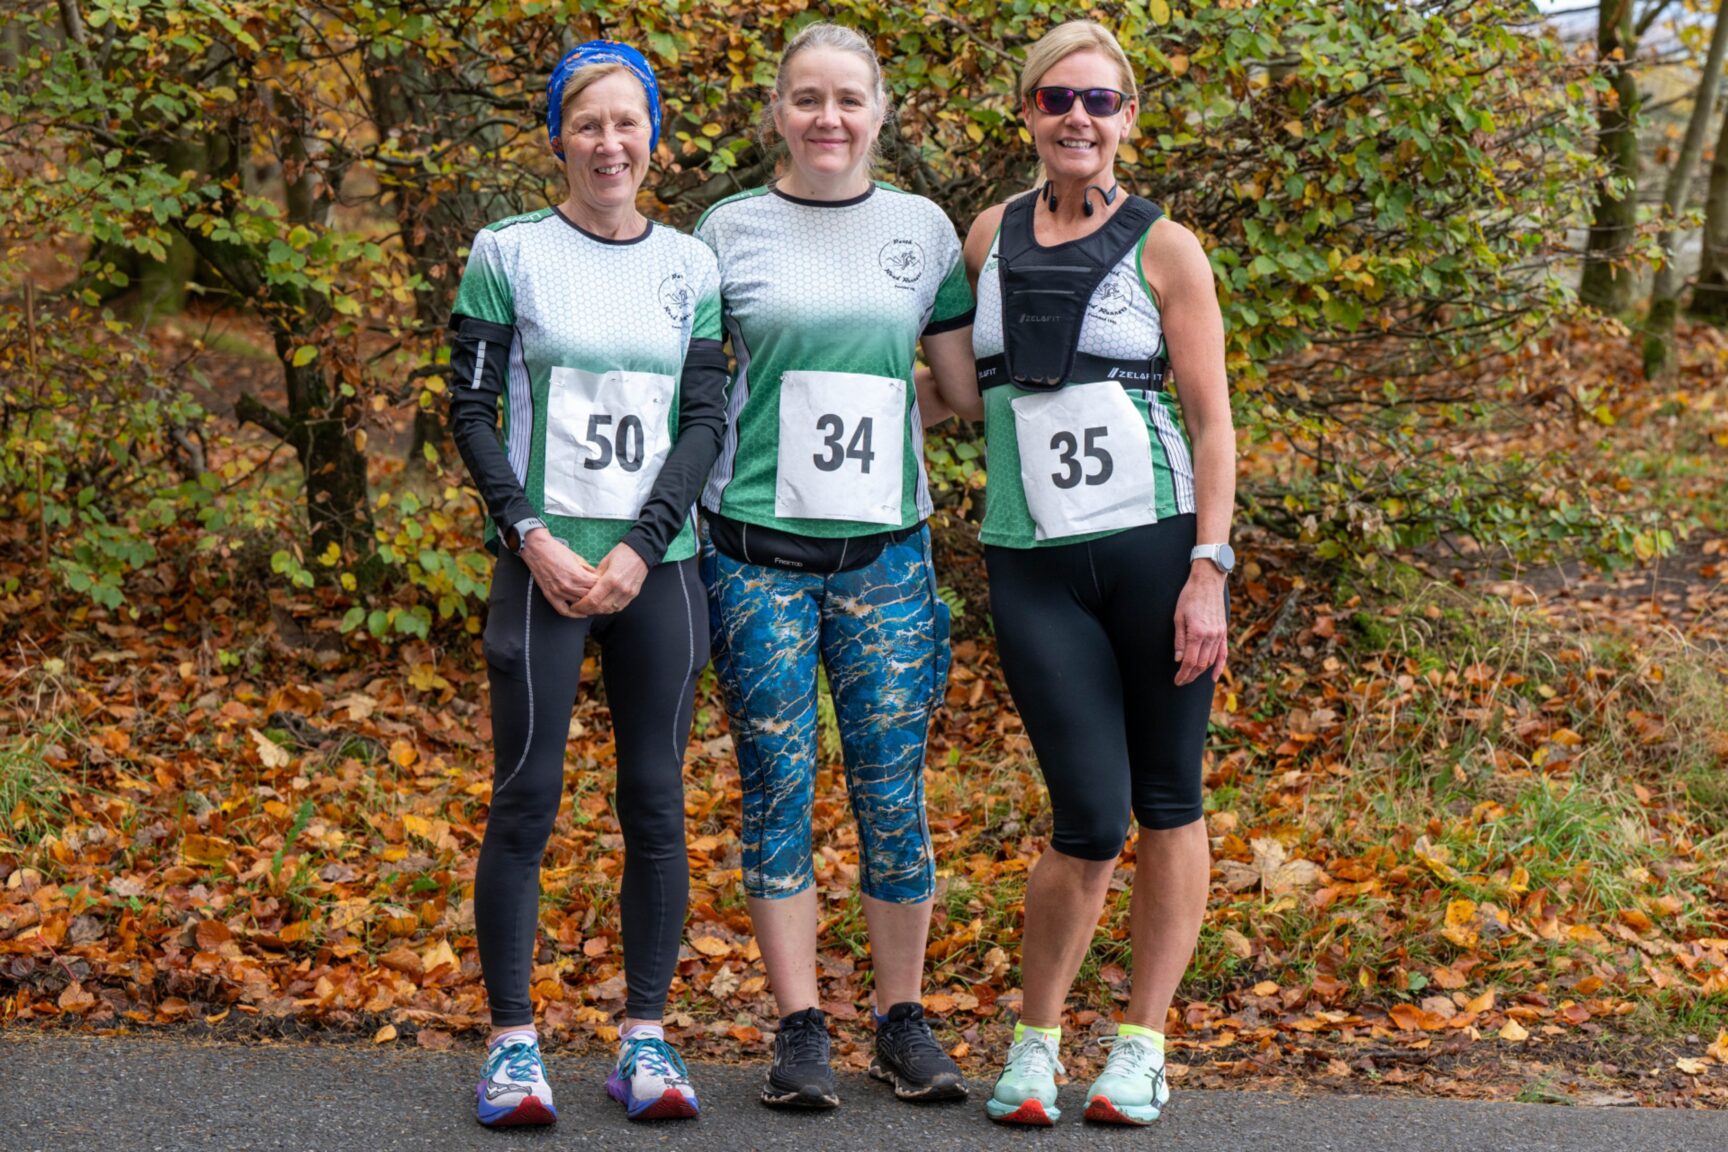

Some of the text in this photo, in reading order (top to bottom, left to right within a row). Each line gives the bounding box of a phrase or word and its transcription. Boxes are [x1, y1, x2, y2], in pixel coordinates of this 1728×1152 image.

[583, 414, 645, 472] 50
[813, 413, 875, 474] 34
[1050, 426, 1114, 489] 35
